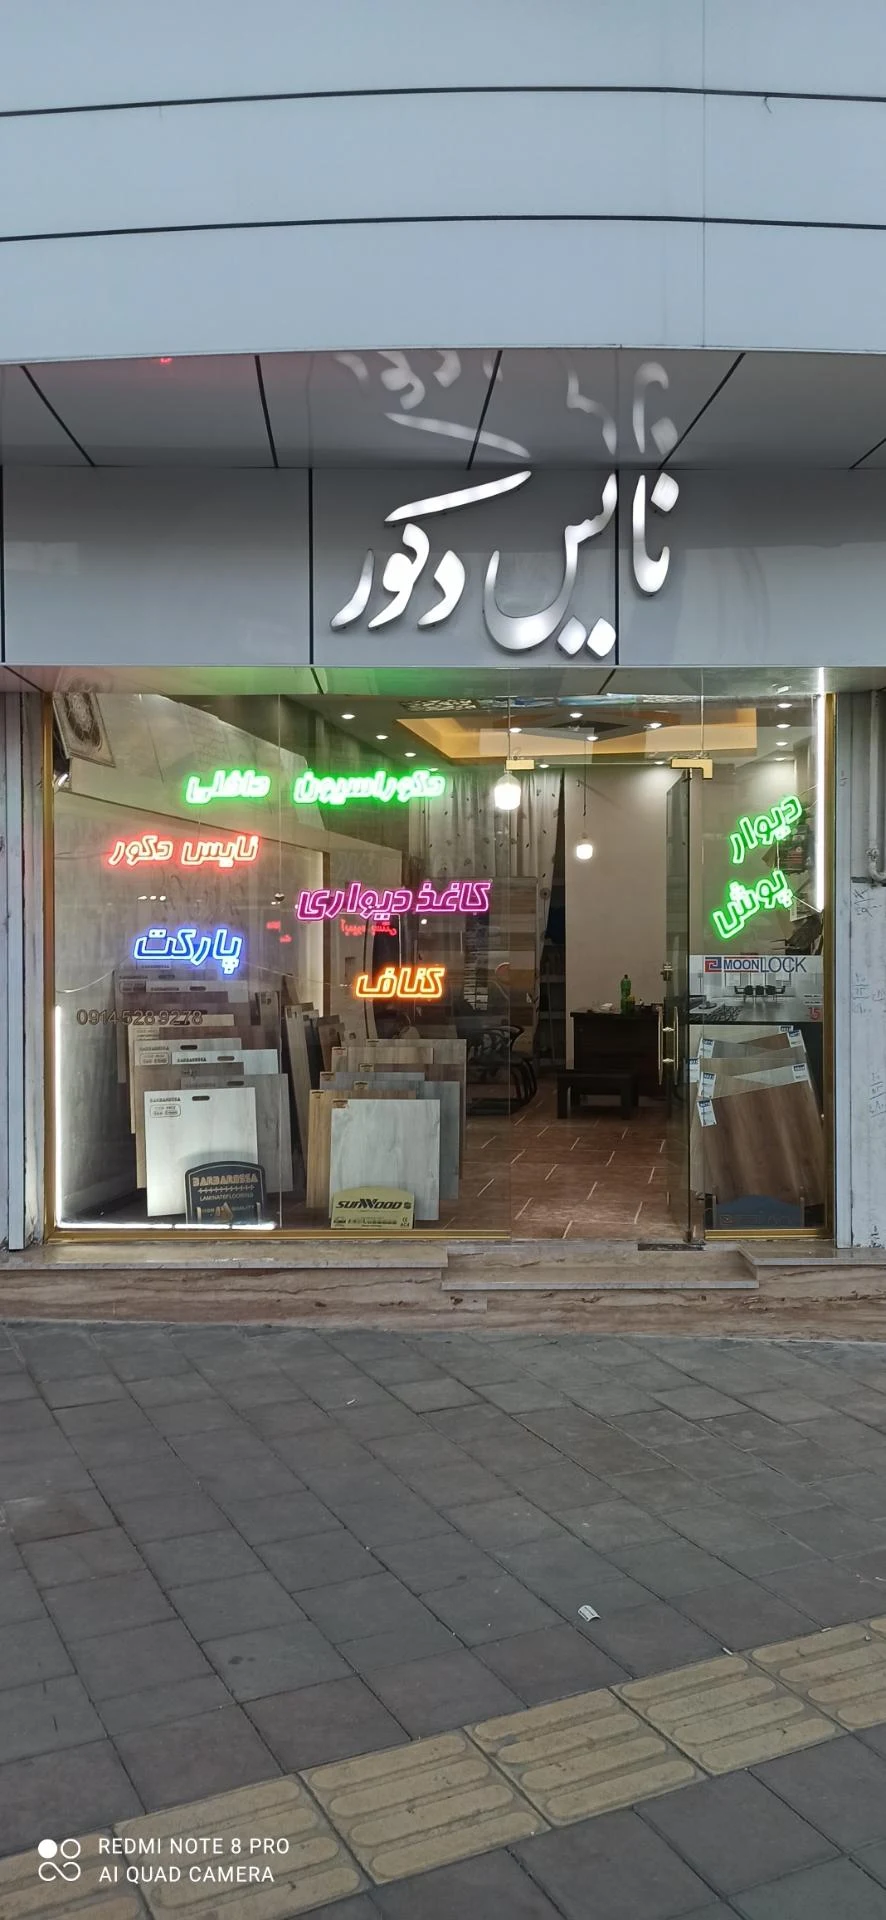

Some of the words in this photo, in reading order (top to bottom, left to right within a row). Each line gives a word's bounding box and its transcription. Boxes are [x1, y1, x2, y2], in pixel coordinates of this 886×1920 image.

[330, 470, 532, 631] دکور
[482, 472, 680, 658] نایس
[729, 795, 802, 864] دیوار
[108, 835, 173, 866] دکور
[181, 835, 259, 868] نایس
[297, 882, 413, 921] دیواری
[415, 882, 492, 914] کاغذ
[133, 929, 243, 975] پارکت
[355, 967, 446, 999] کناف
